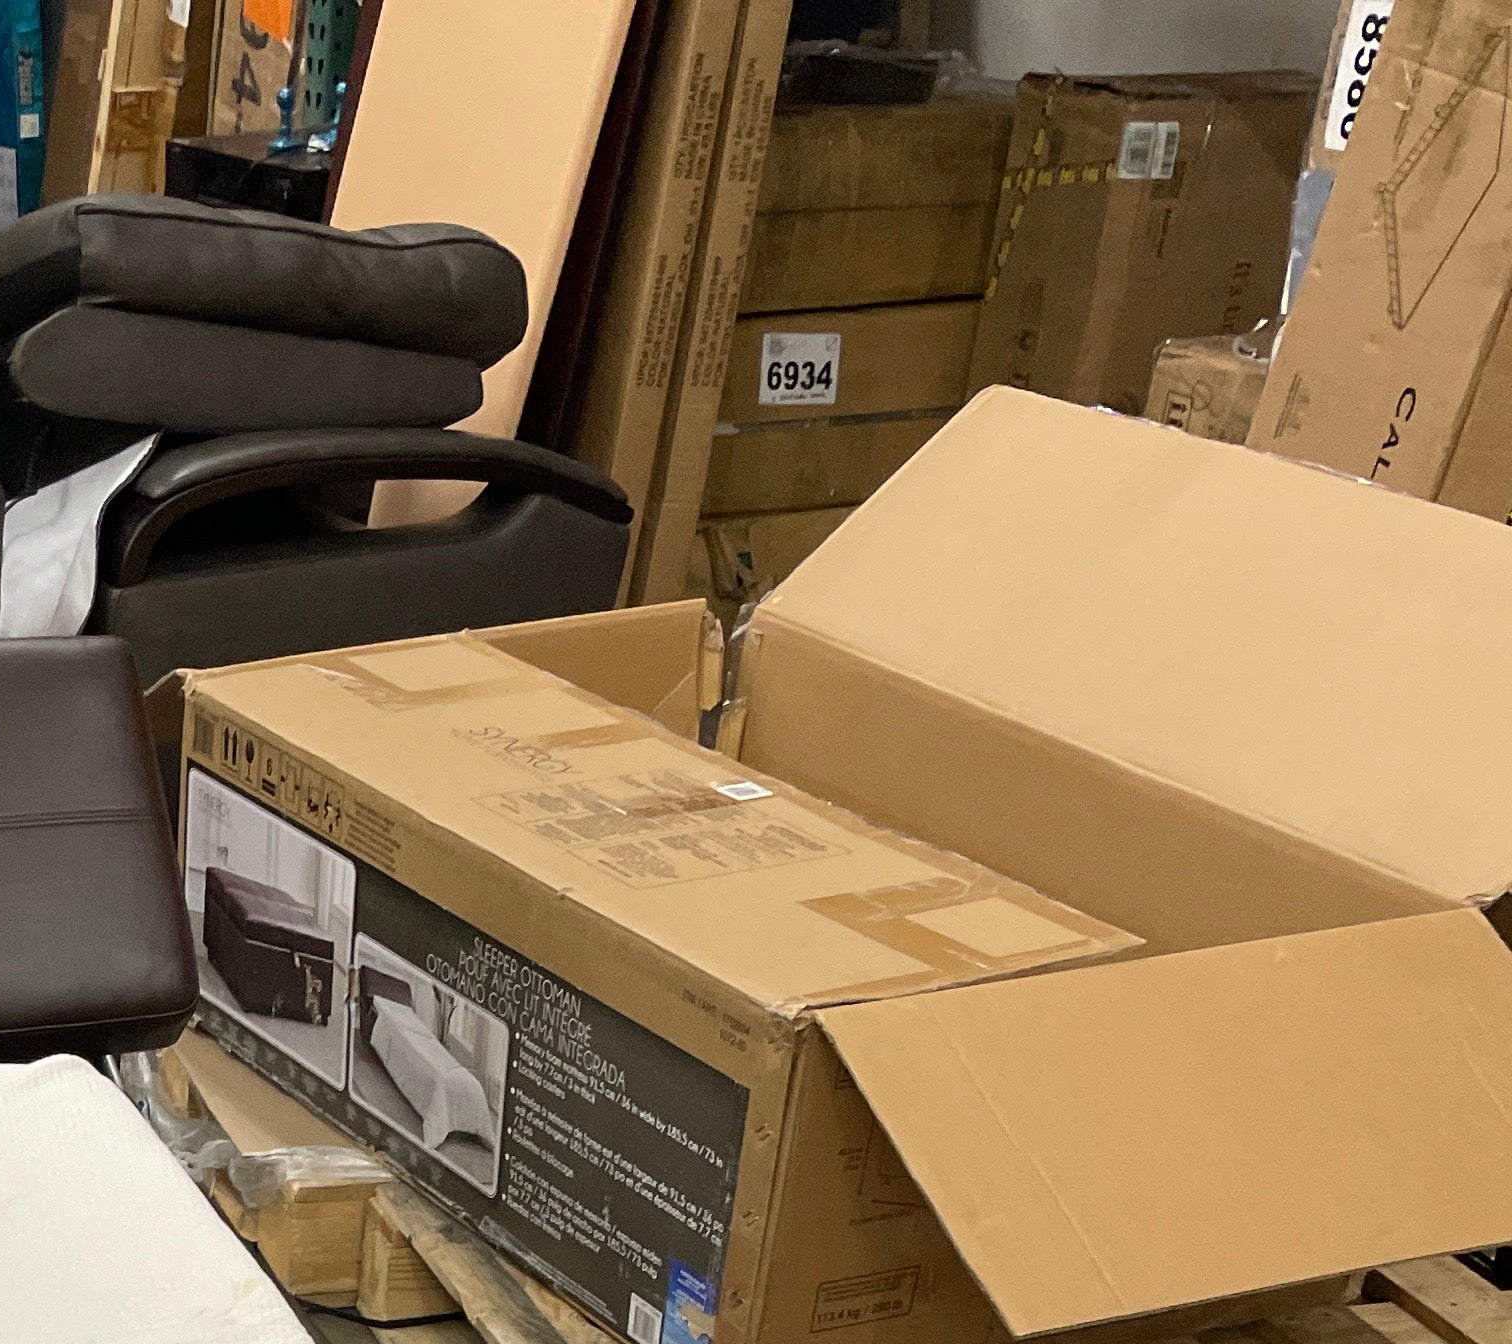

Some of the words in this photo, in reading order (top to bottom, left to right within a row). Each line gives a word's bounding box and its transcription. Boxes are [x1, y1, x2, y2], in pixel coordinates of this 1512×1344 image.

[767, 361, 832, 390] 6934
[459, 951, 489, 982] POUF
[491, 972, 521, 1004] AVEC
[524, 991, 539, 1017] LIT
[475, 937, 518, 977] SLEEPER
[521, 966, 581, 1017] OTTOMAN
[426, 954, 486, 1004] OTOMANO
[488, 992, 518, 1025] CON
[520, 1011, 553, 1047] CAMA
[558, 1033, 626, 1092] INTEGRADA
